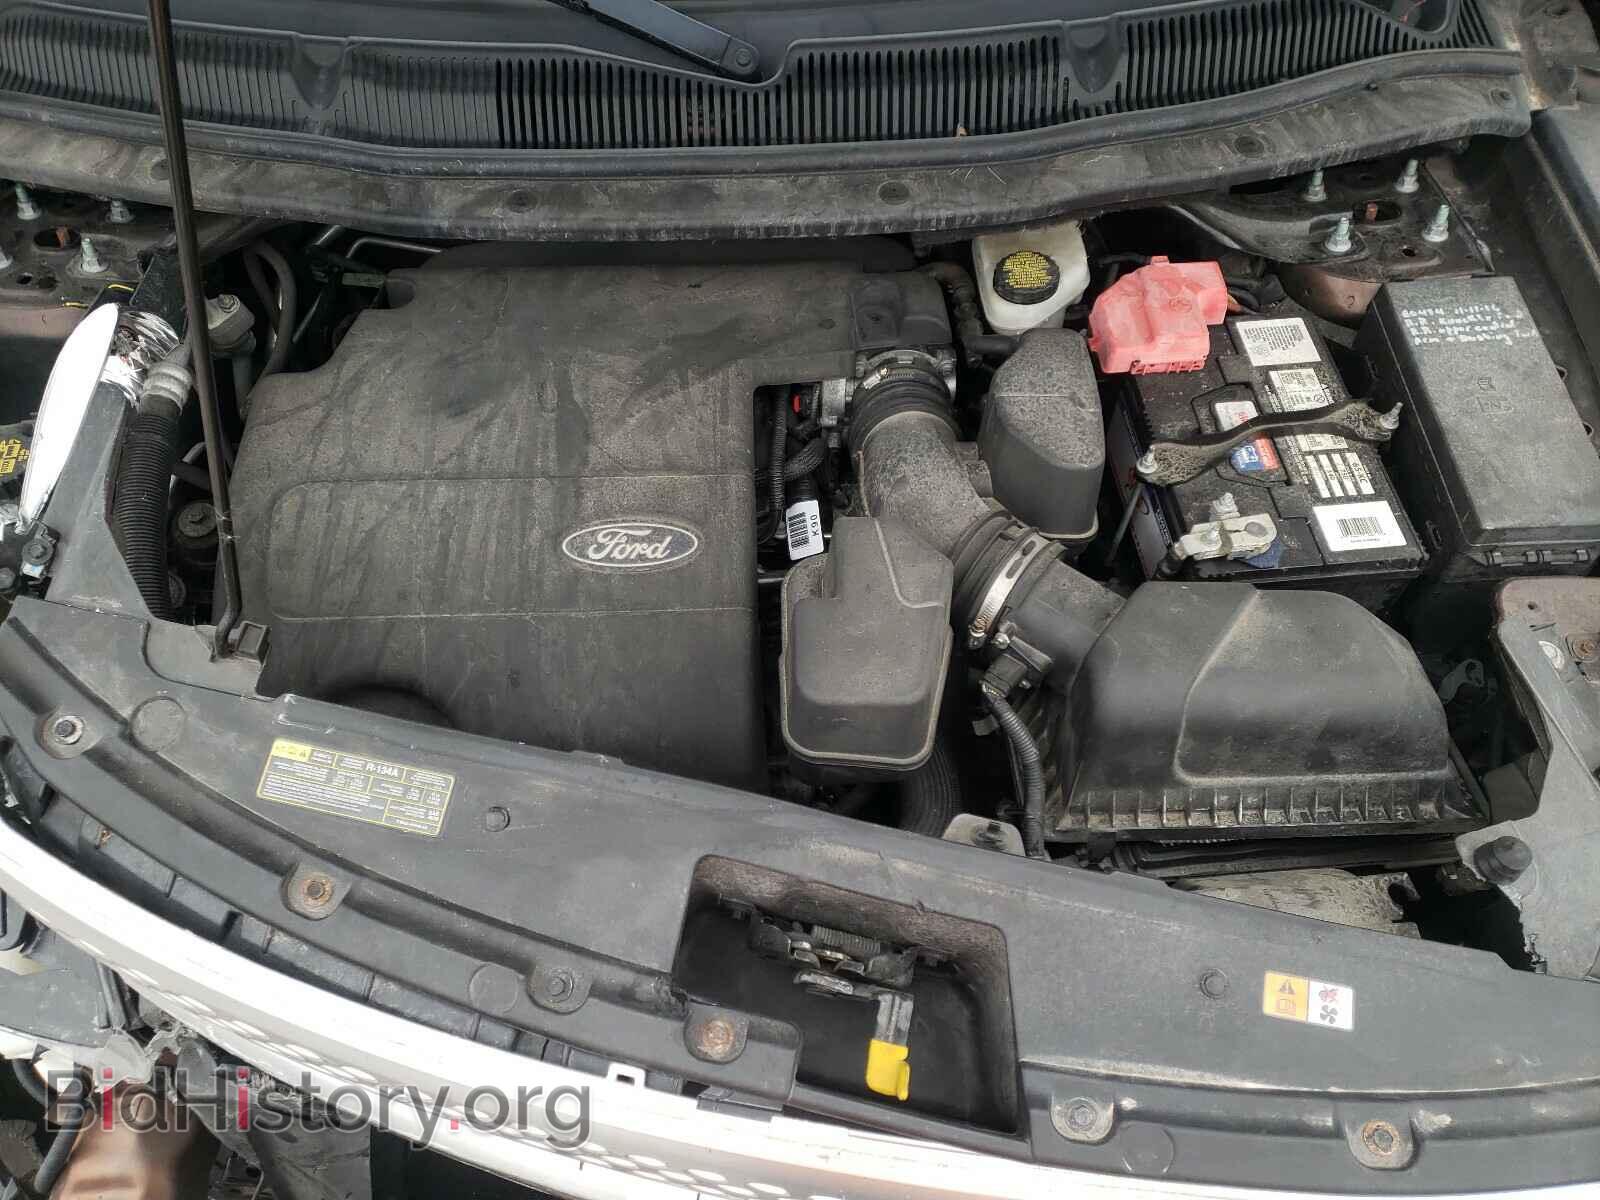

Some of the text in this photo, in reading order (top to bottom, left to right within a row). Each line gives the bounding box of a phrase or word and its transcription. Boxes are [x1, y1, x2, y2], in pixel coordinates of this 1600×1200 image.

[810, 514, 820, 537] K90
[588, 528, 672, 560] Ford
[366, 763, 399, 777] R-134A
